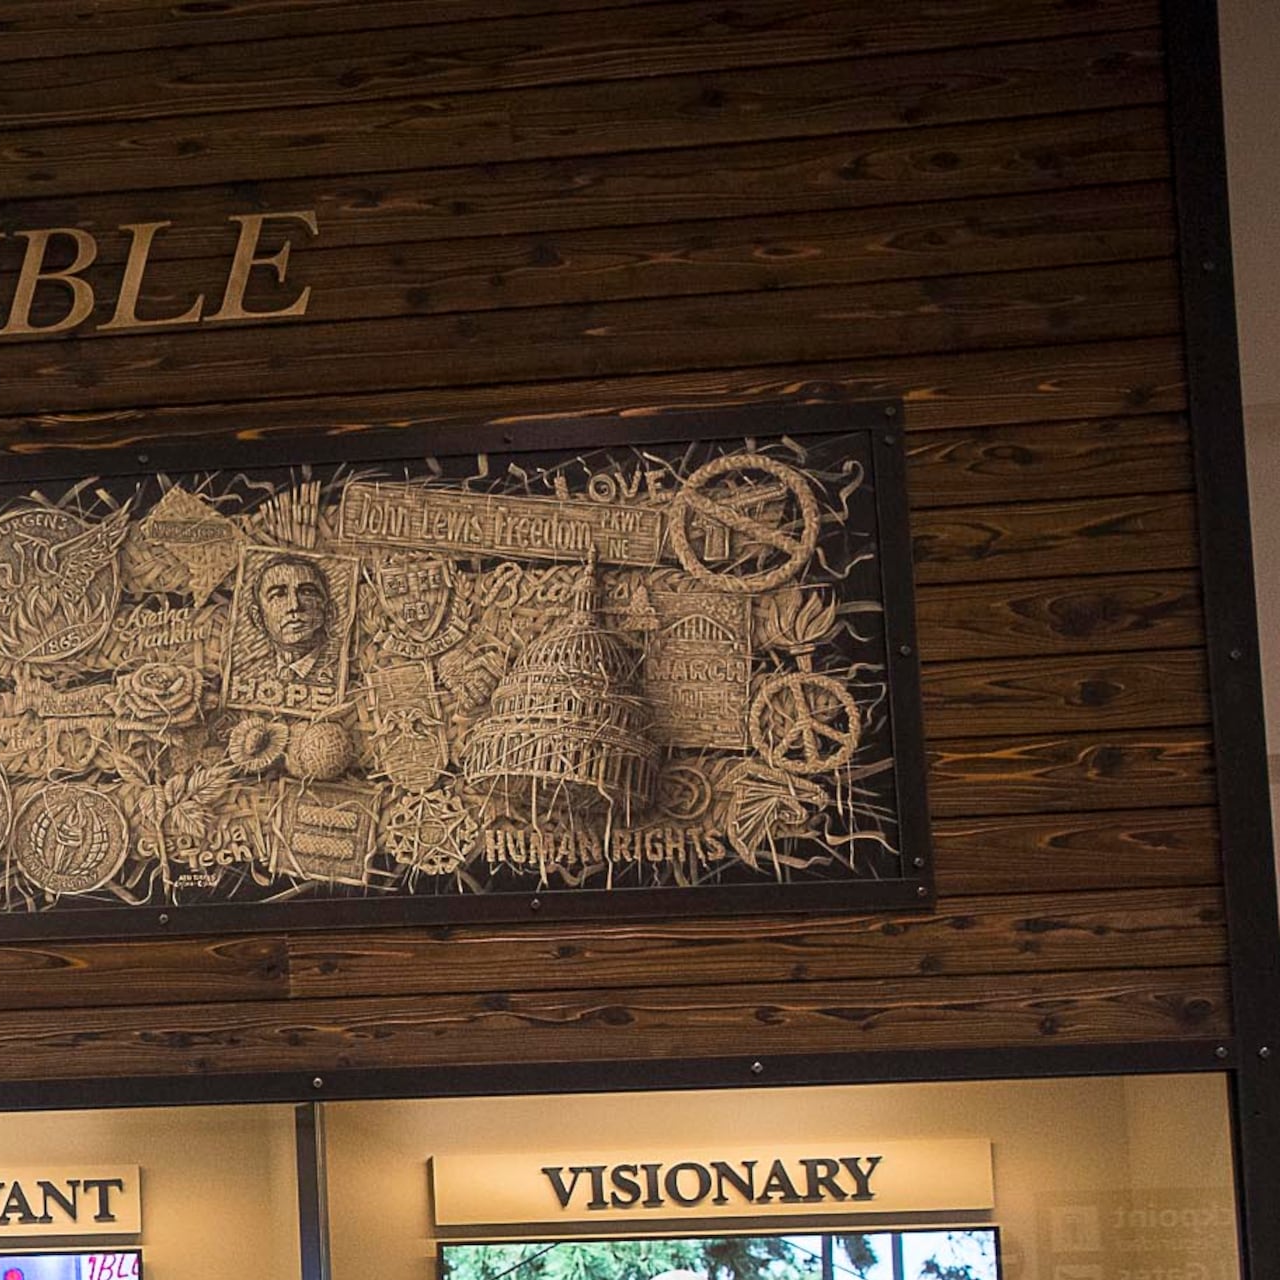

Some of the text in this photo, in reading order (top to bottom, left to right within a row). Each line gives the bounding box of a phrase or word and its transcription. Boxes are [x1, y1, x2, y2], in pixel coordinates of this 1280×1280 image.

[355, 494, 591, 550] John Lewis Freedom
[608, 538, 629, 558] NE
[649, 658, 747, 683] MARCH
[231, 675, 337, 709] HOPE
[485, 826, 725, 865] HUMAN RIGHTS
[542, 1155, 884, 1210] VISIONARY
